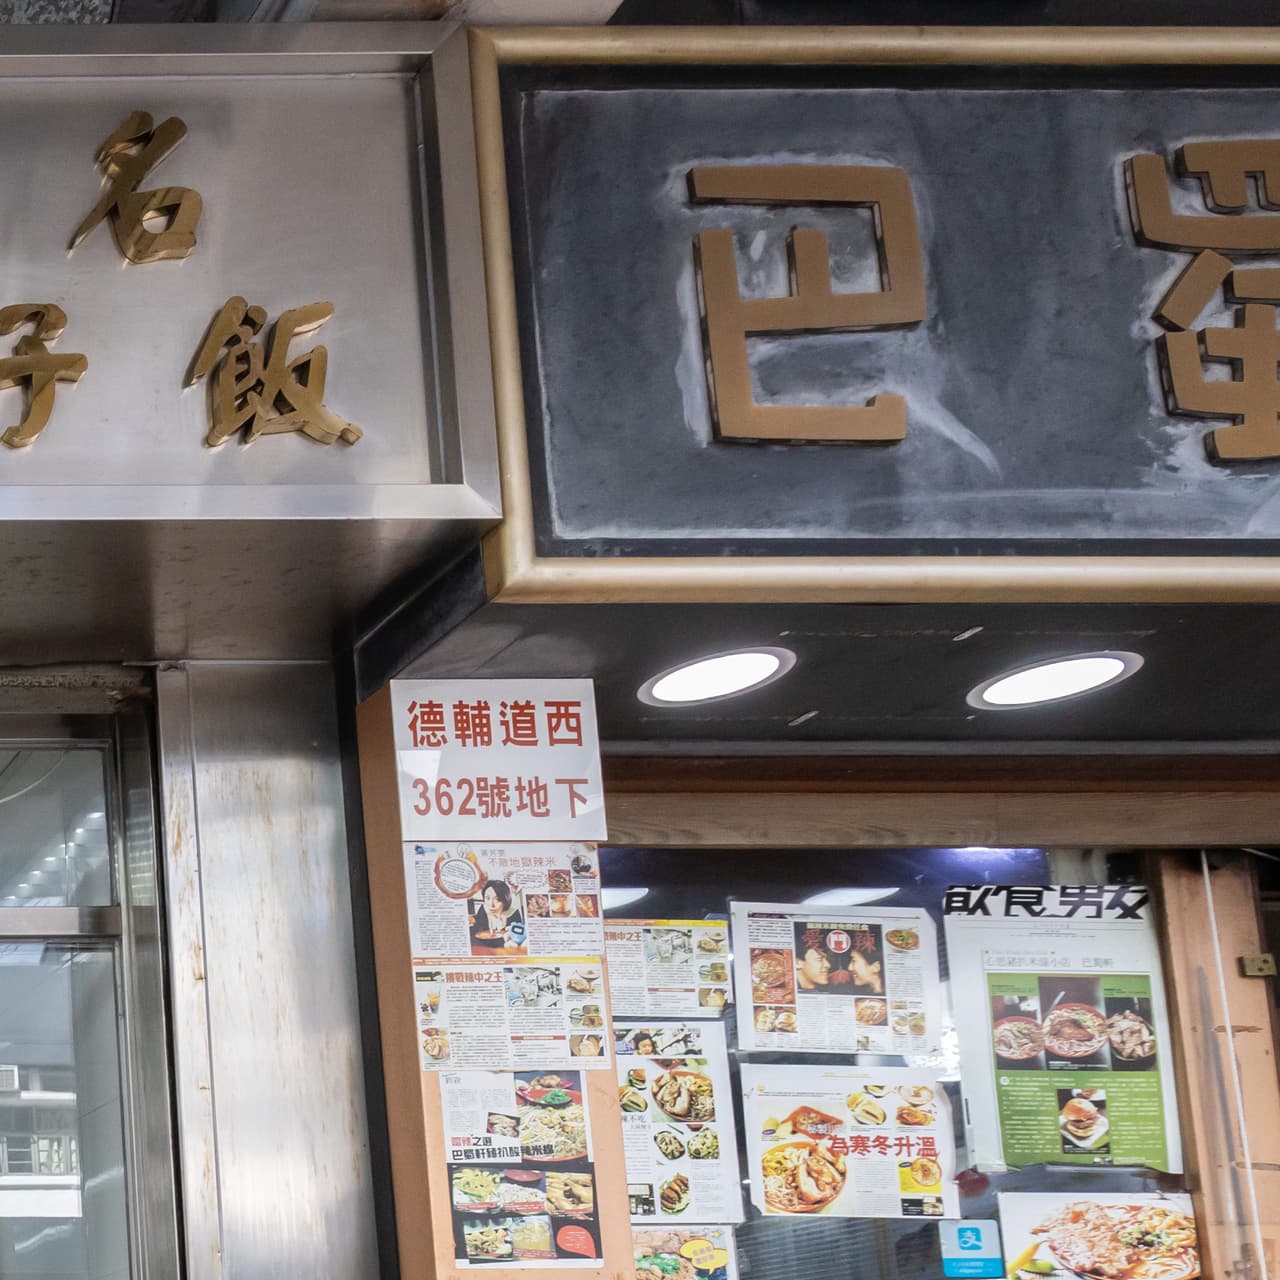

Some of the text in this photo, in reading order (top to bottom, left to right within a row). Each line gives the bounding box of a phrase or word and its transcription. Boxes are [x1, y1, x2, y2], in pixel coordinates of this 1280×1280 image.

[407, 700, 583, 747] 德輔道西
[412, 776, 588, 818] 362號地下
[944, 885, 1148, 919] 飲食男女
